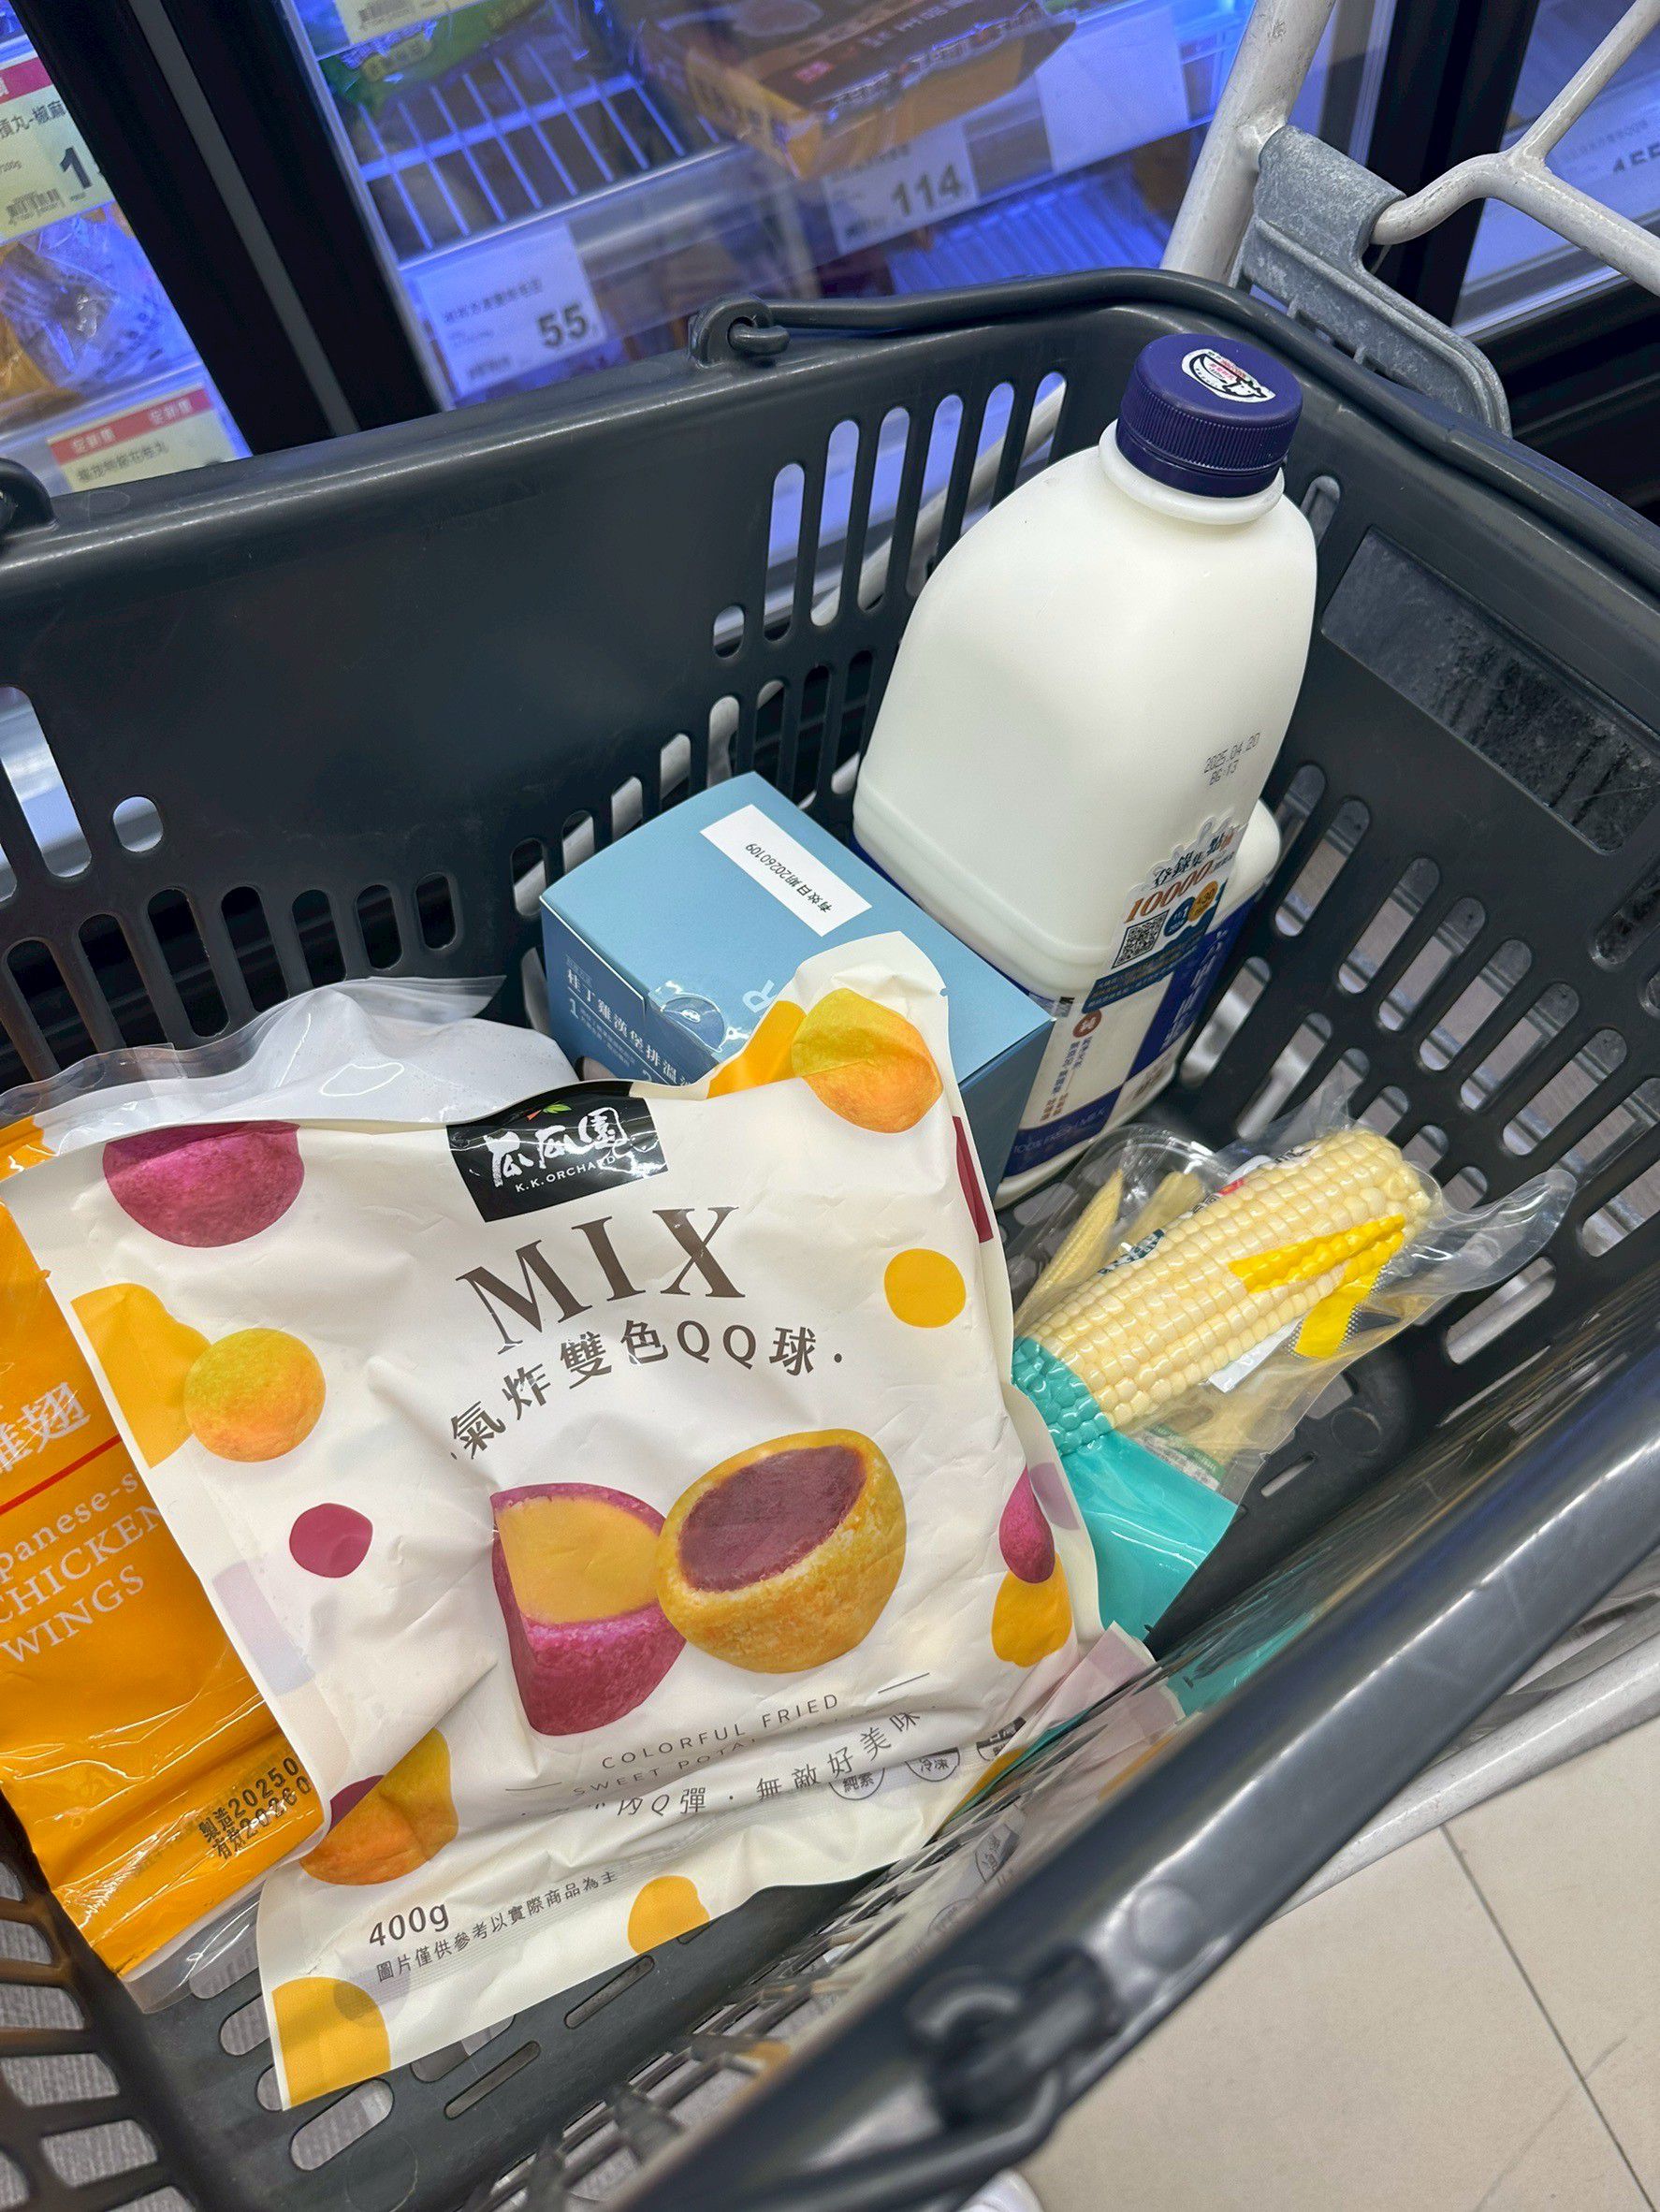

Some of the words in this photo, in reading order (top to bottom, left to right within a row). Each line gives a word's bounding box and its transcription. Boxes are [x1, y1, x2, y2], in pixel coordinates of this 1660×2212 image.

[891, 163, 962, 217] 114
[537, 298, 589, 349] 55
[745, 840, 833, 914] 有效日期20260109
[1123, 860, 1215, 924] 10000
[742, 979, 778, 1013] R
[456, 1204, 746, 1355] MIX
[1, 1564, 145, 1663] WINGS
[602, 1723, 747, 1768] COLORFUL
[762, 1694, 838, 1728] FRIED
[573, 1768, 660, 1796] SWEET
[677, 1740, 752, 1769] POTA
[369, 1903, 450, 1946] 400g
[375, 1870, 618, 1983] 圖片僅供參考以實際商品為主
